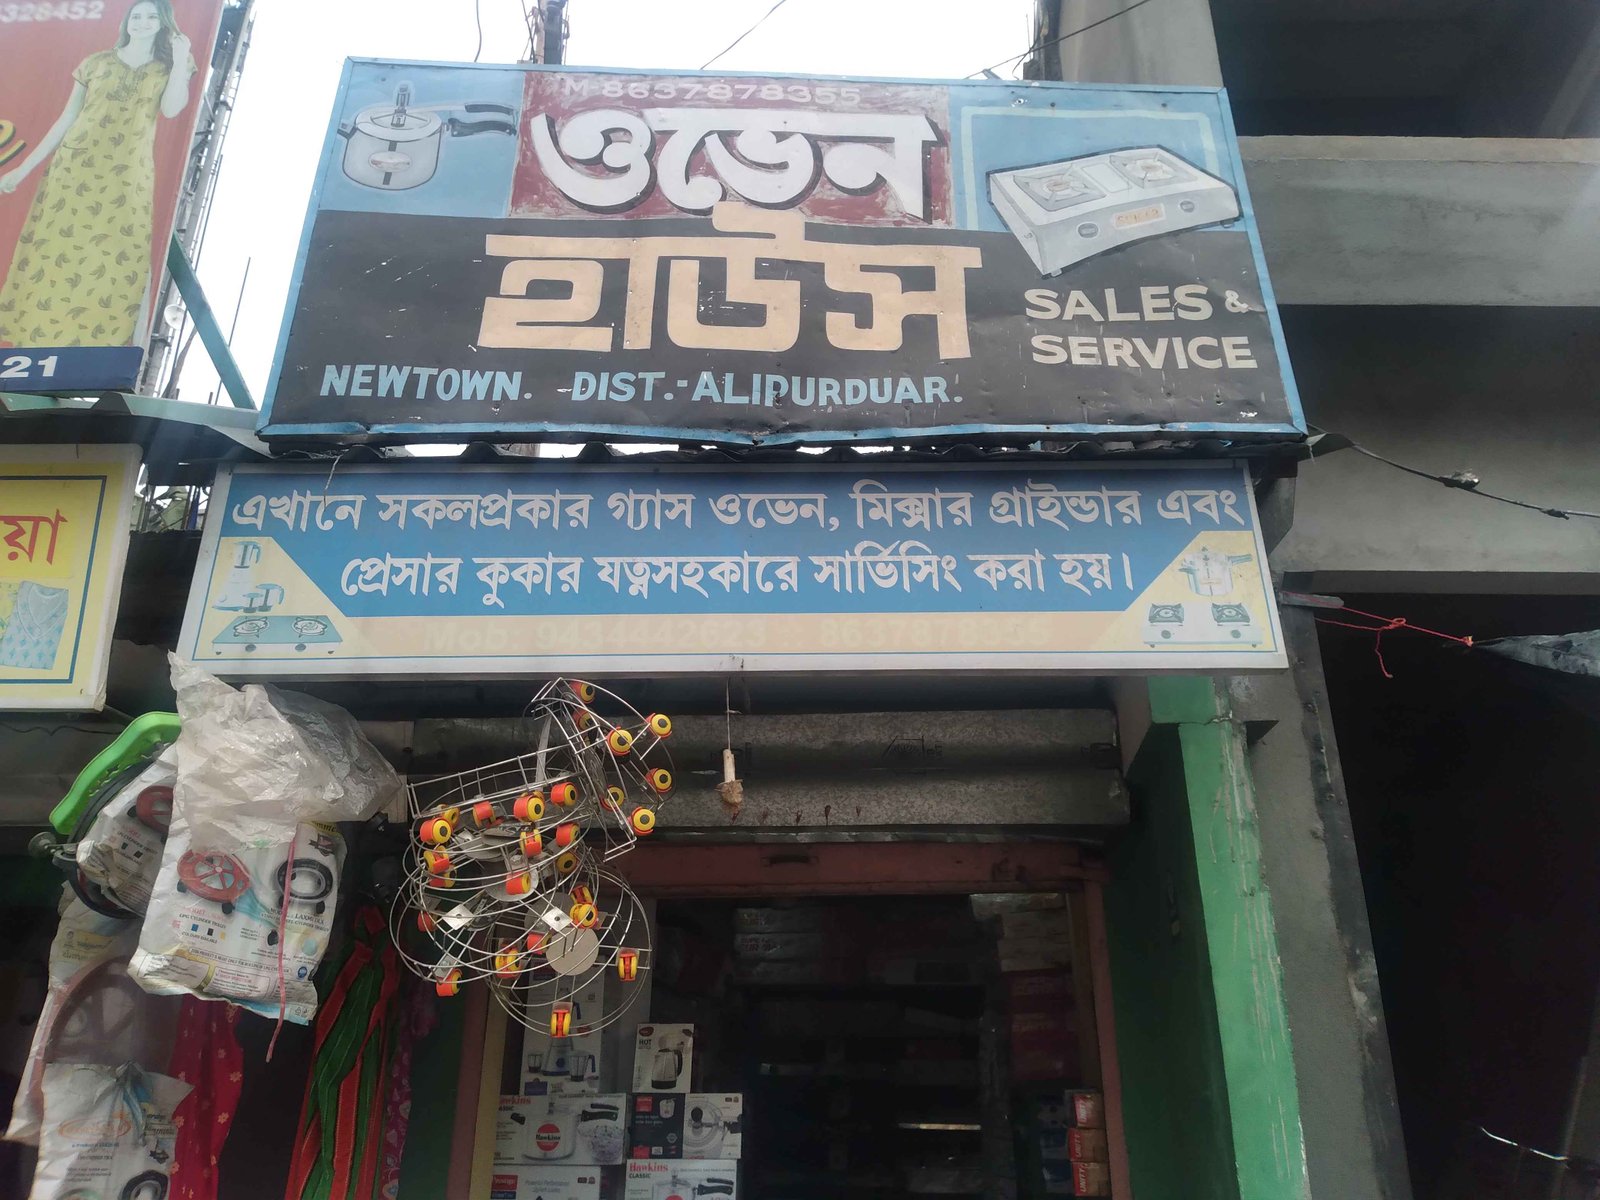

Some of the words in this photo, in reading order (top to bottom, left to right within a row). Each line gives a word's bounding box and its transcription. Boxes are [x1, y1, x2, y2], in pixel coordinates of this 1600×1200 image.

[530, 107, 943, 222] ওভেন
[477, 201, 982, 360] হাউস
[1023, 284, 1213, 322] SALES
[1224, 289, 1250, 313] &
[1030, 334, 1258, 369] SERVICE
[319, 363, 533, 402] NEWTOWN.
[231, 489, 367, 533] এখানে
[606, 487, 696, 531] গ্যাস
[709, 491, 841, 532] ওভেন,
[848, 478, 974, 531] মিক্সার
[988, 478, 1142, 530] গ্রাইন্ডার
[1156, 488, 1246, 527] এবং
[340, 551, 464, 598] প্রেসার
[472, 551, 585, 609] কুকার
[592, 550, 801, 599] যত্নসহকারে
[808, 540, 962, 595] সার্ভিসিং
[966, 548, 1046, 593] করা
[423, 620, 520, 652] Mob:
[629, 1162, 669, 1173] Hawkins
